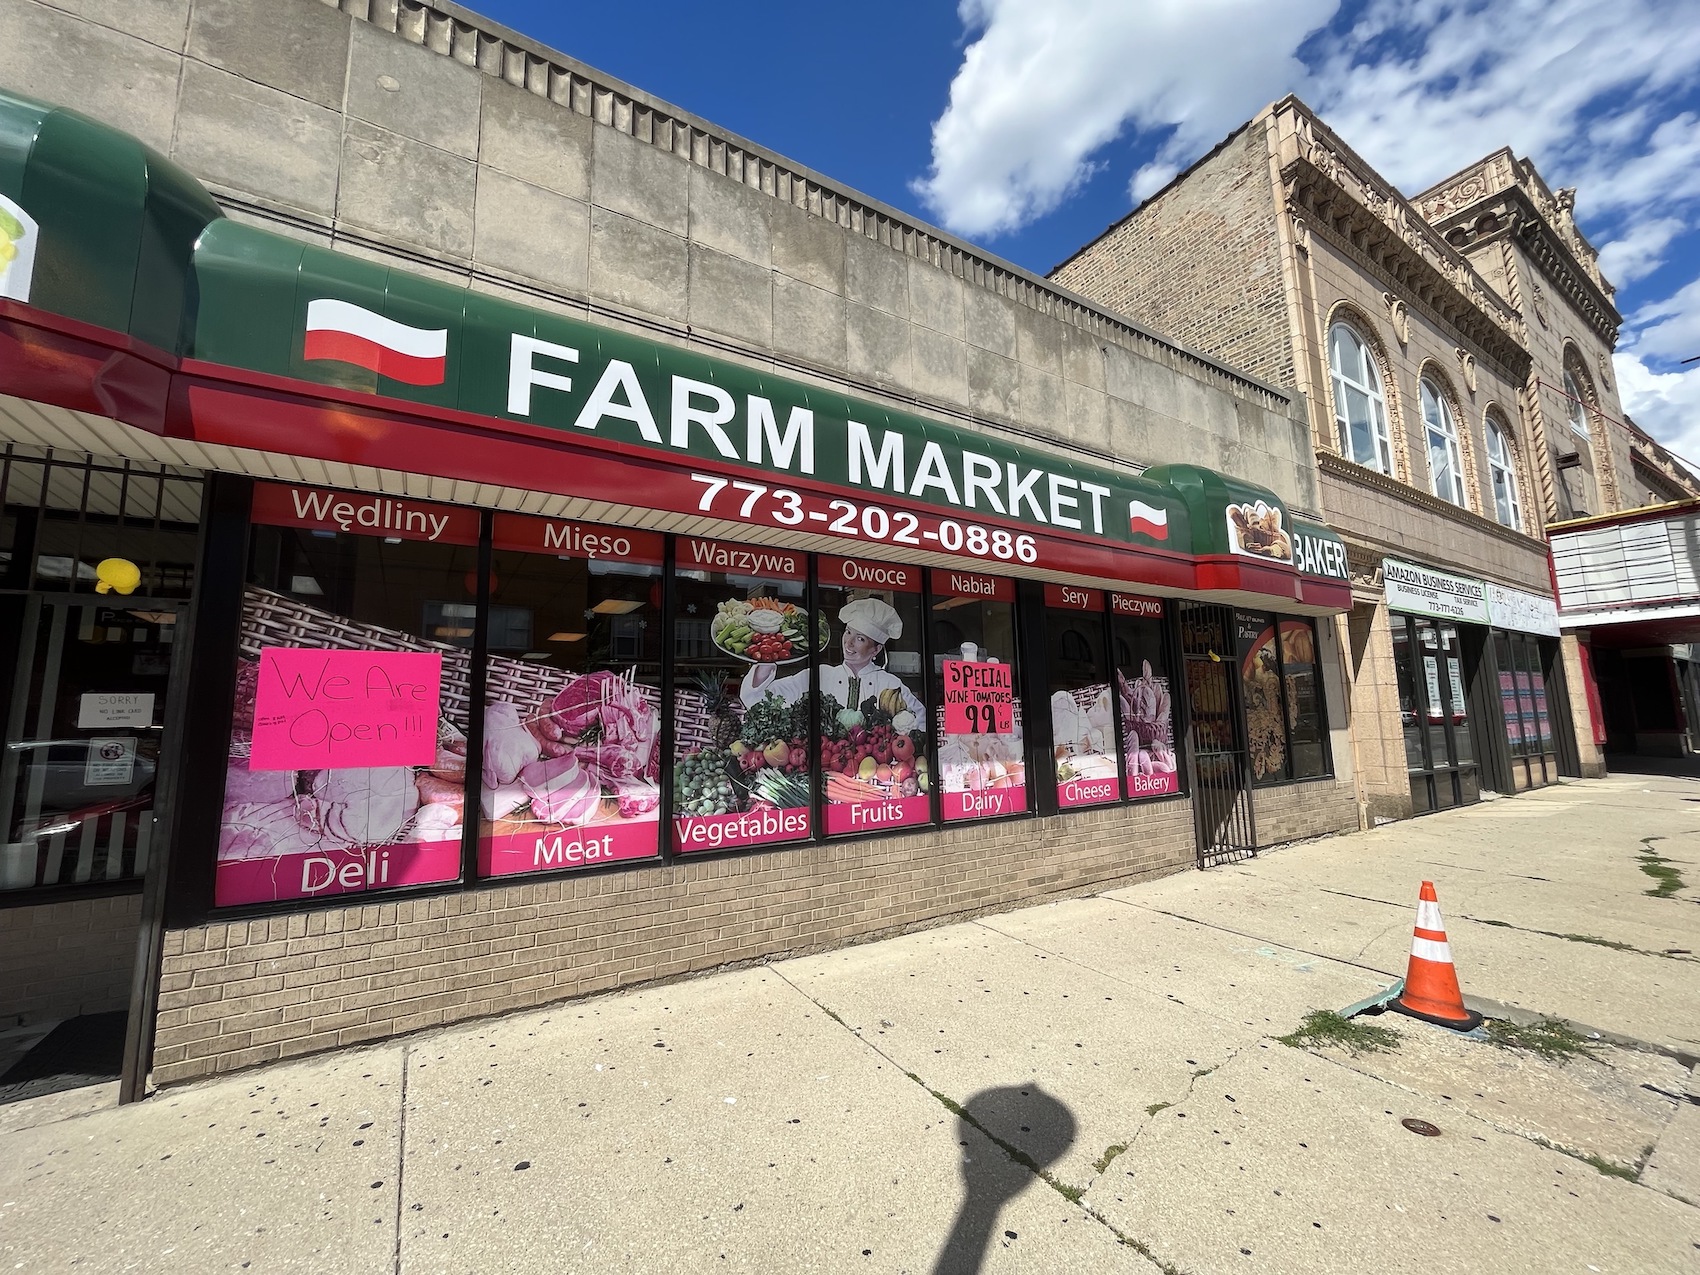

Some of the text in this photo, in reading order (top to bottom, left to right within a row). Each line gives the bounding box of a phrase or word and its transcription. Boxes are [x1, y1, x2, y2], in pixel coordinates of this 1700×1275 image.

[508, 333, 1110, 534] FARM MARKET
[291, 489, 449, 541] Wędliny
[690, 473, 1038, 563] 773-202-0886
[544, 523, 631, 558] Mięso
[691, 540, 795, 575] Warzywa
[1293, 533, 1350, 580] BAKER
[842, 560, 907, 585] Owoce
[951, 574, 995, 595] Nabiał
[1387, 564, 1482, 598] AMAZON BUSINESS SERVICES
[1062, 586, 1088, 608] Sery
[1112, 594, 1161, 615] Pieczywo
[1397, 584, 1439, 600] BUSINESS LICENSE
[1463, 598, 1478, 608] SERVICE
[271, 657, 427, 701] We Are
[949, 662, 1011, 688] SPECIAL
[98, 695, 139, 705] SORRY
[946, 690, 1011, 704] VINE TOMATOES
[289, 708, 423, 754] Open!!!
[1065, 781, 1111, 801] Cheese
[1134, 776, 1170, 792] Bakery
[851, 801, 904, 825] Fruits
[962, 792, 1003, 813] Dairy
[675, 812, 808, 847] Vegetables
[533, 834, 614, 866] Meat
[301, 850, 389, 893] Deli
